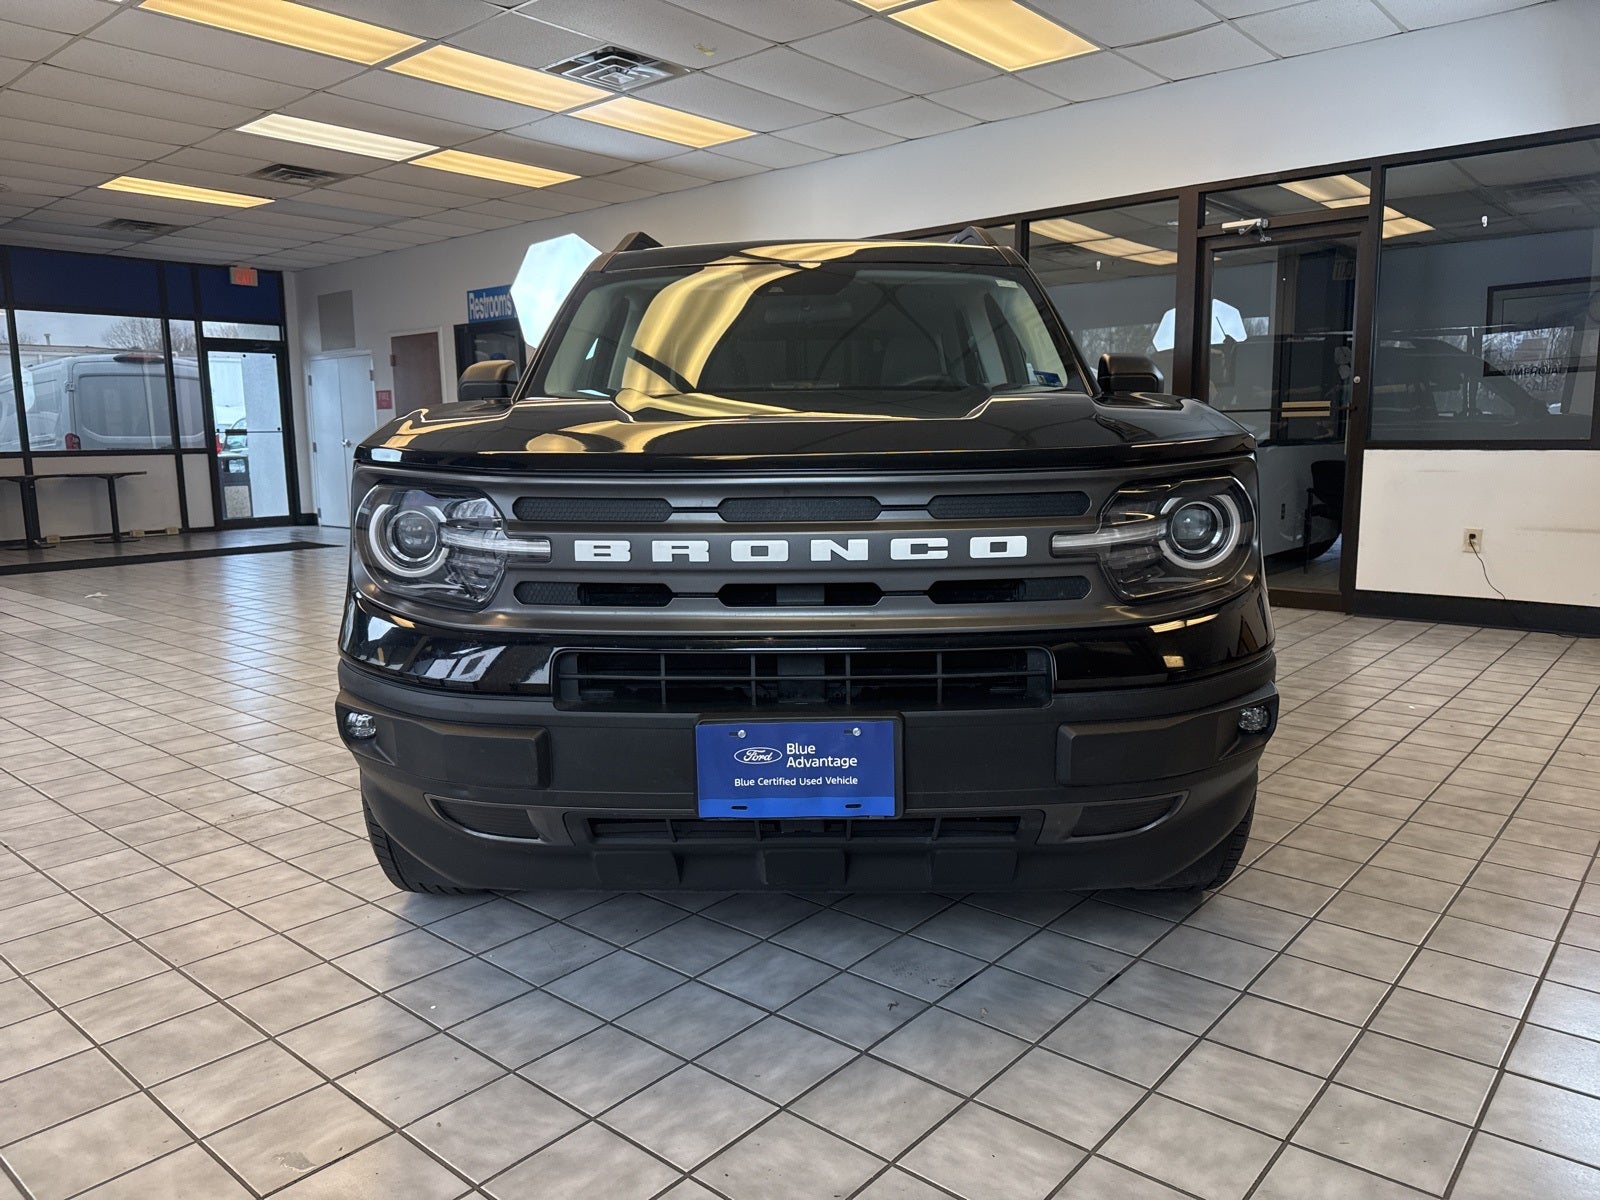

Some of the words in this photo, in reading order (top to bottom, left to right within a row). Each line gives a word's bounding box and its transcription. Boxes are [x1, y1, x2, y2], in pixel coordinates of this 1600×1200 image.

[468, 291, 513, 320] Restrooms
[574, 535, 1028, 563] BRONCO
[786, 742, 816, 755] Blue
[743, 749, 773, 762] Ford
[786, 755, 858, 769] Advantage
[734, 777, 755, 787] Blue
[757, 776, 797, 787] Certified
[799, 776, 823, 786] Used
[825, 775, 858, 786] Vehicle
